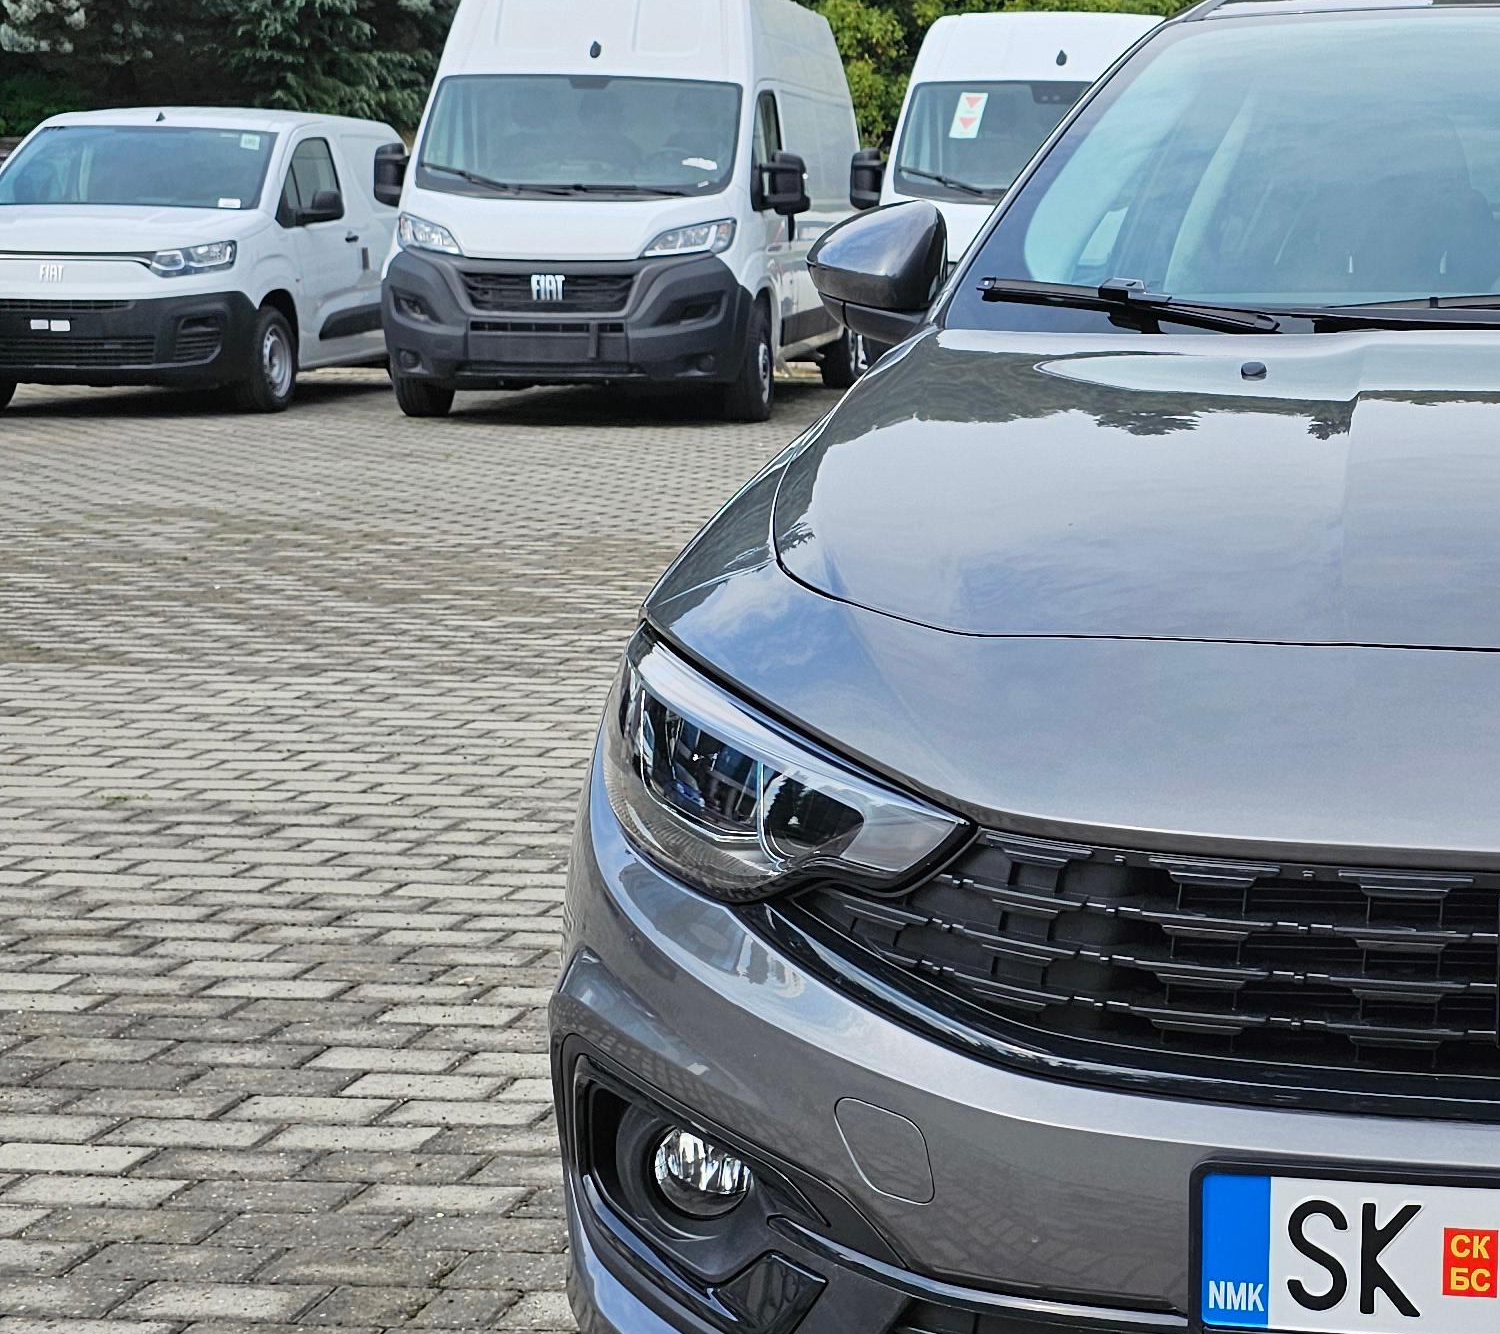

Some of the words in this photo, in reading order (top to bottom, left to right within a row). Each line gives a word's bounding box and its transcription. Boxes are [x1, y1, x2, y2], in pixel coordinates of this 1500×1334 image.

[40, 263, 64, 283] FIAT
[530, 274, 566, 301] FIAT
[1287, 1199, 1422, 1317] SK
[1450, 1267, 1491, 1292] БС
[1208, 1280, 1264, 1312] NMK
